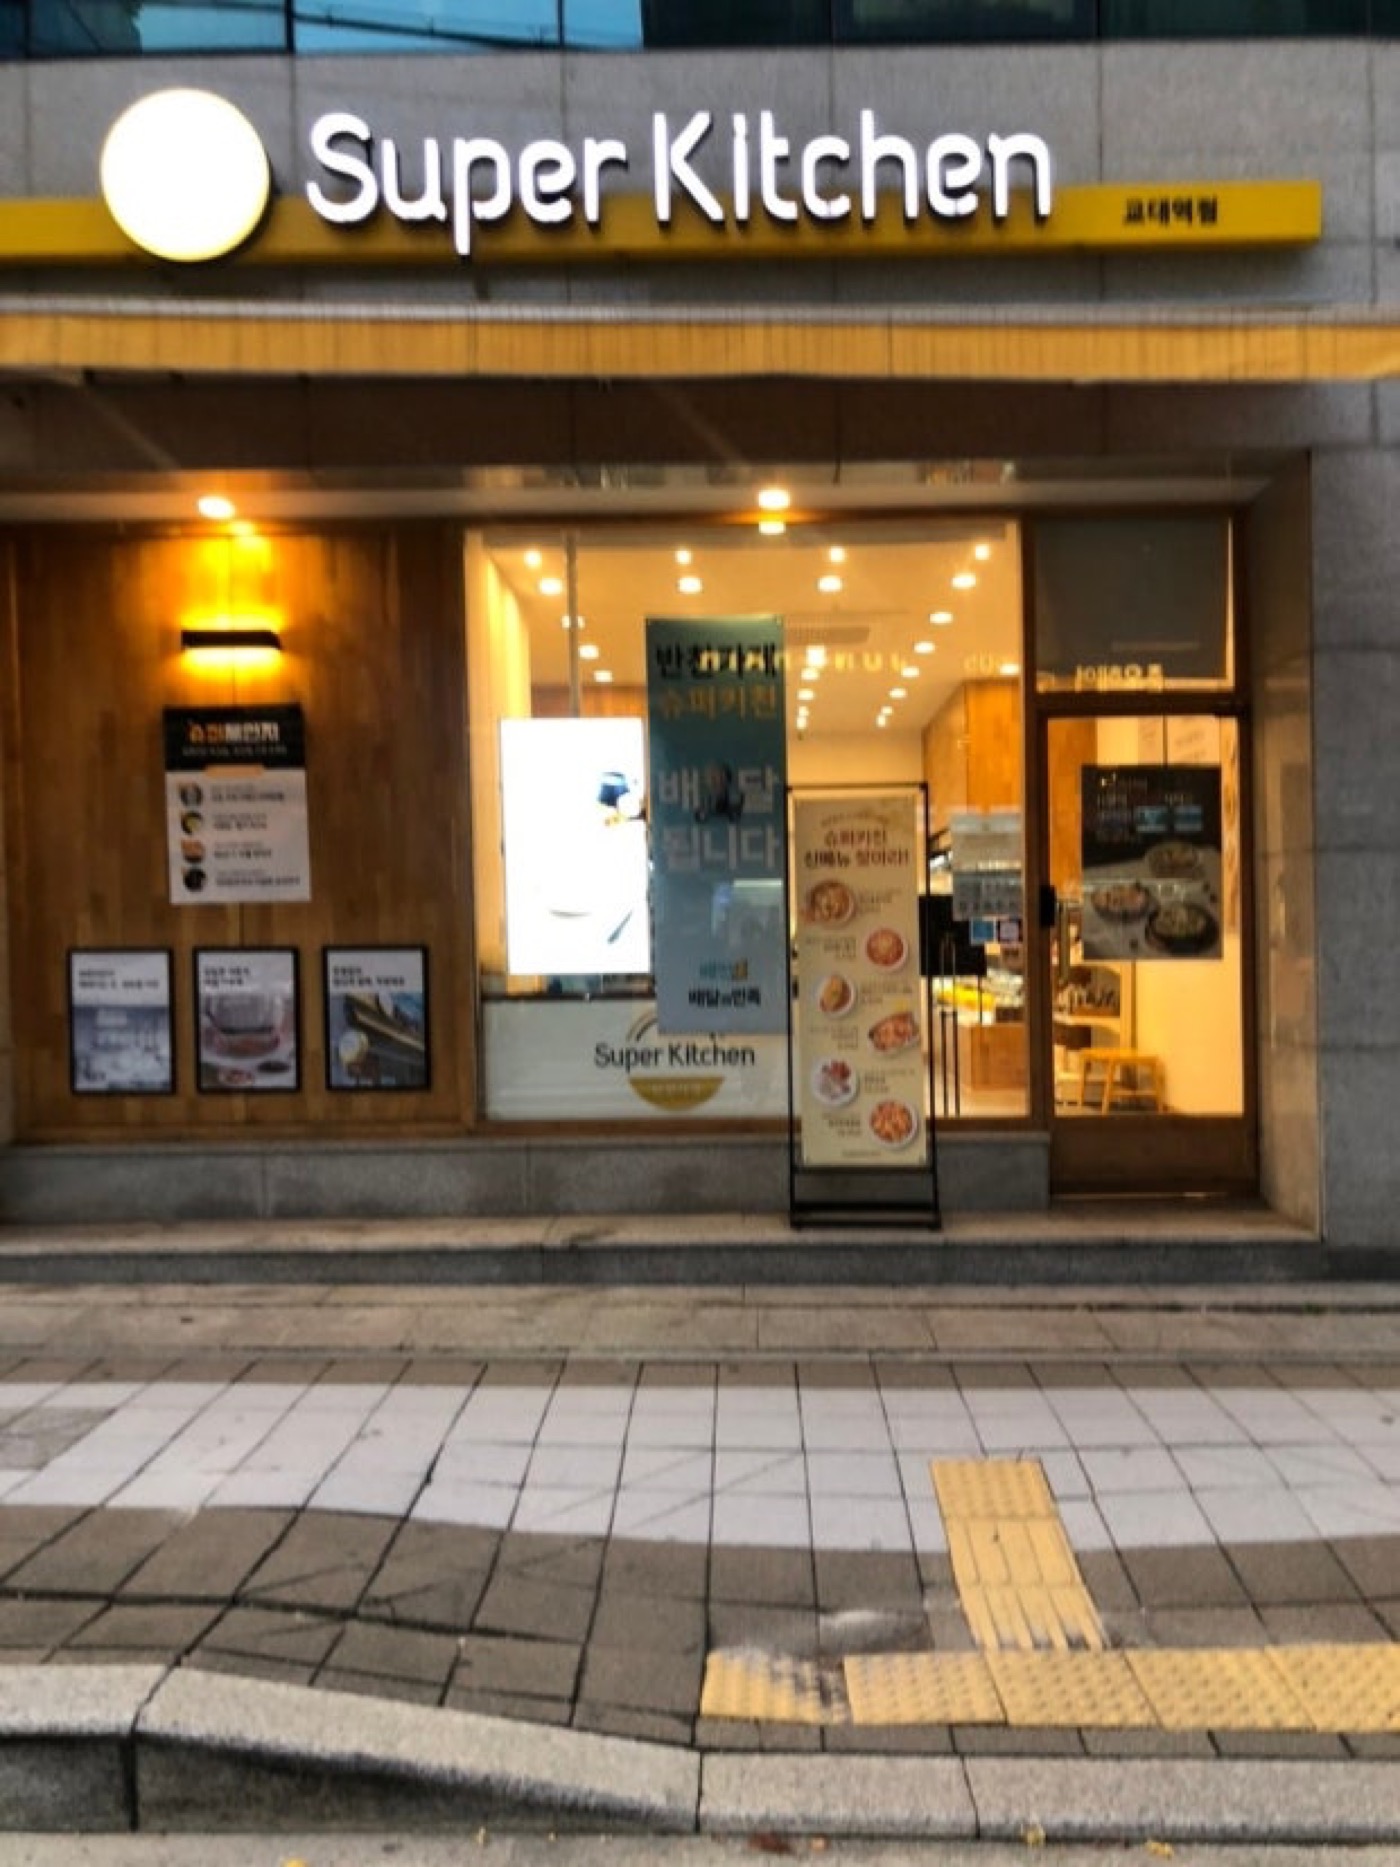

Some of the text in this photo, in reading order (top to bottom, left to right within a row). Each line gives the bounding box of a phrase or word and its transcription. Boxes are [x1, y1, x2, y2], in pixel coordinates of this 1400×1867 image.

[306, 109, 1053, 256] Super Kitchen
[662, 823, 780, 870] 됩니다
[594, 1041, 756, 1073] Super Kitchen
